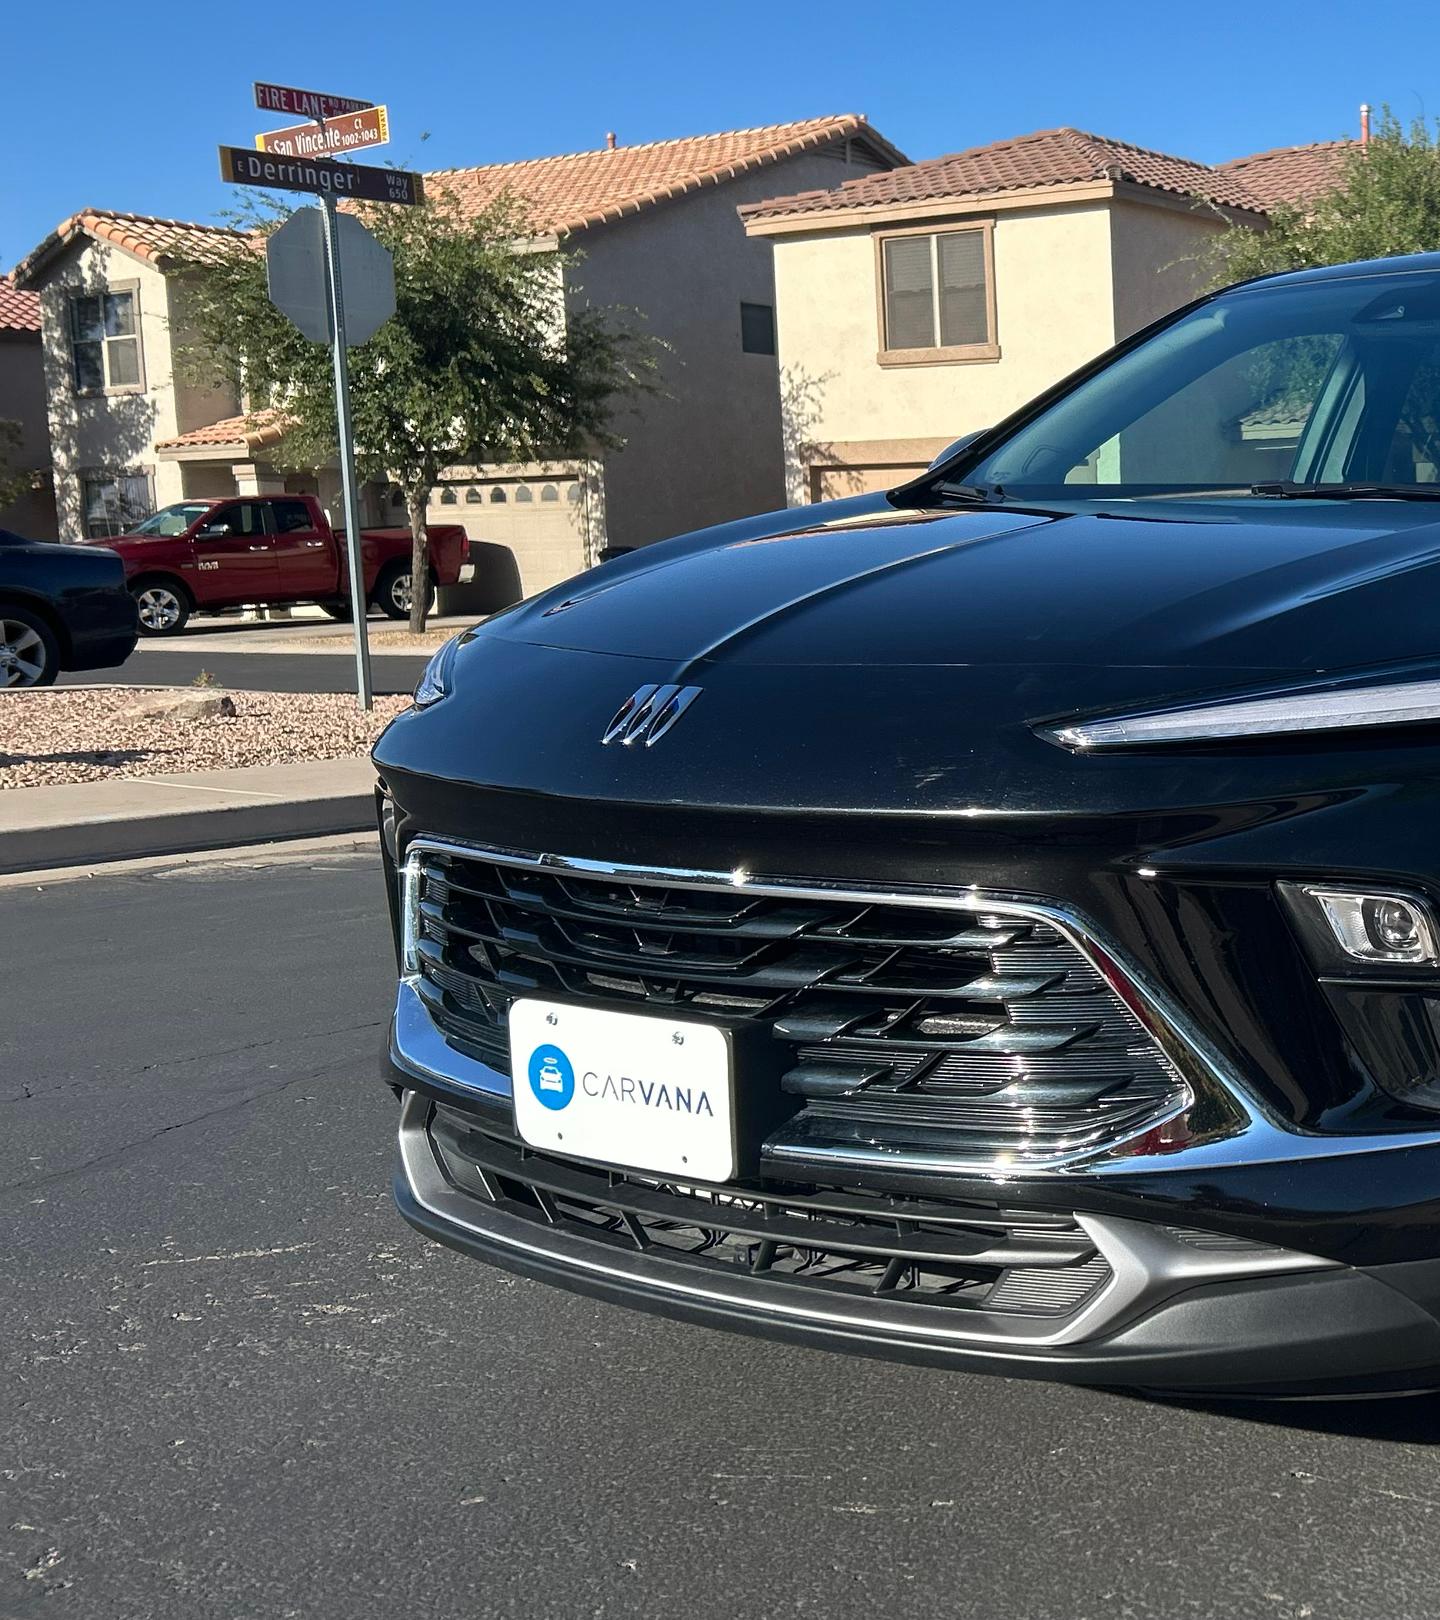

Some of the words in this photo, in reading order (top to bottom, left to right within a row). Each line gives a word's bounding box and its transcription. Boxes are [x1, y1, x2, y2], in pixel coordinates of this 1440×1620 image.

[256, 85, 289, 110] FIRE
[293, 91, 328, 117] LANE
[341, 128, 378, 146] 1002-1043
[354, 118, 363, 130] Ct
[274, 139, 293, 156] San
[295, 128, 341, 154] Vincente
[237, 160, 244, 172] E
[248, 157, 354, 192] Derringer
[389, 187, 408, 200] 650
[582, 1071, 714, 1118] CARVANA
